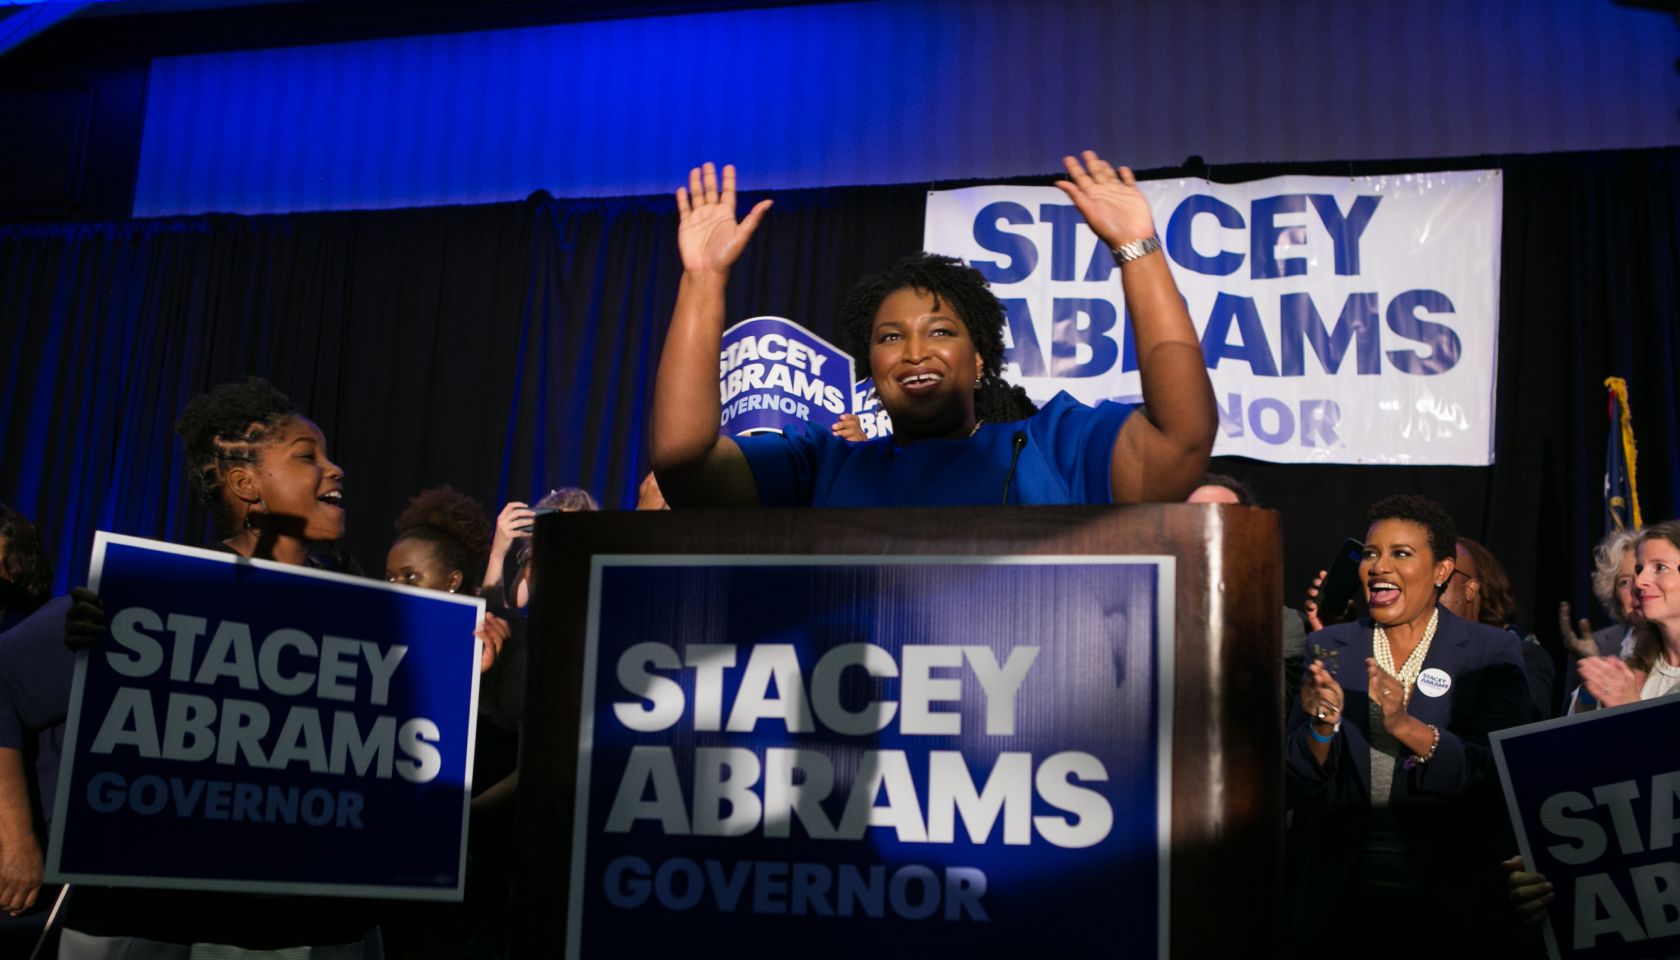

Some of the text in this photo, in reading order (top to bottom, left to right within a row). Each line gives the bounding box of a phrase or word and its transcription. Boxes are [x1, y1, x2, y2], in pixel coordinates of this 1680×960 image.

[1001, 289, 1463, 378] ABAMS
[721, 393, 810, 427] OVERNOR
[106, 606, 408, 706] STACEY
[612, 641, 1042, 736] STACEY
[1420, 677, 1449, 689] ABRAMS
[1422, 673, 1447, 684] STACEY
[90, 686, 442, 784] ABRAMS
[86, 771, 365, 830] GOVERNOR
[603, 745, 1114, 849] ABRAMS
[602, 855, 991, 923] GOVERNOR
